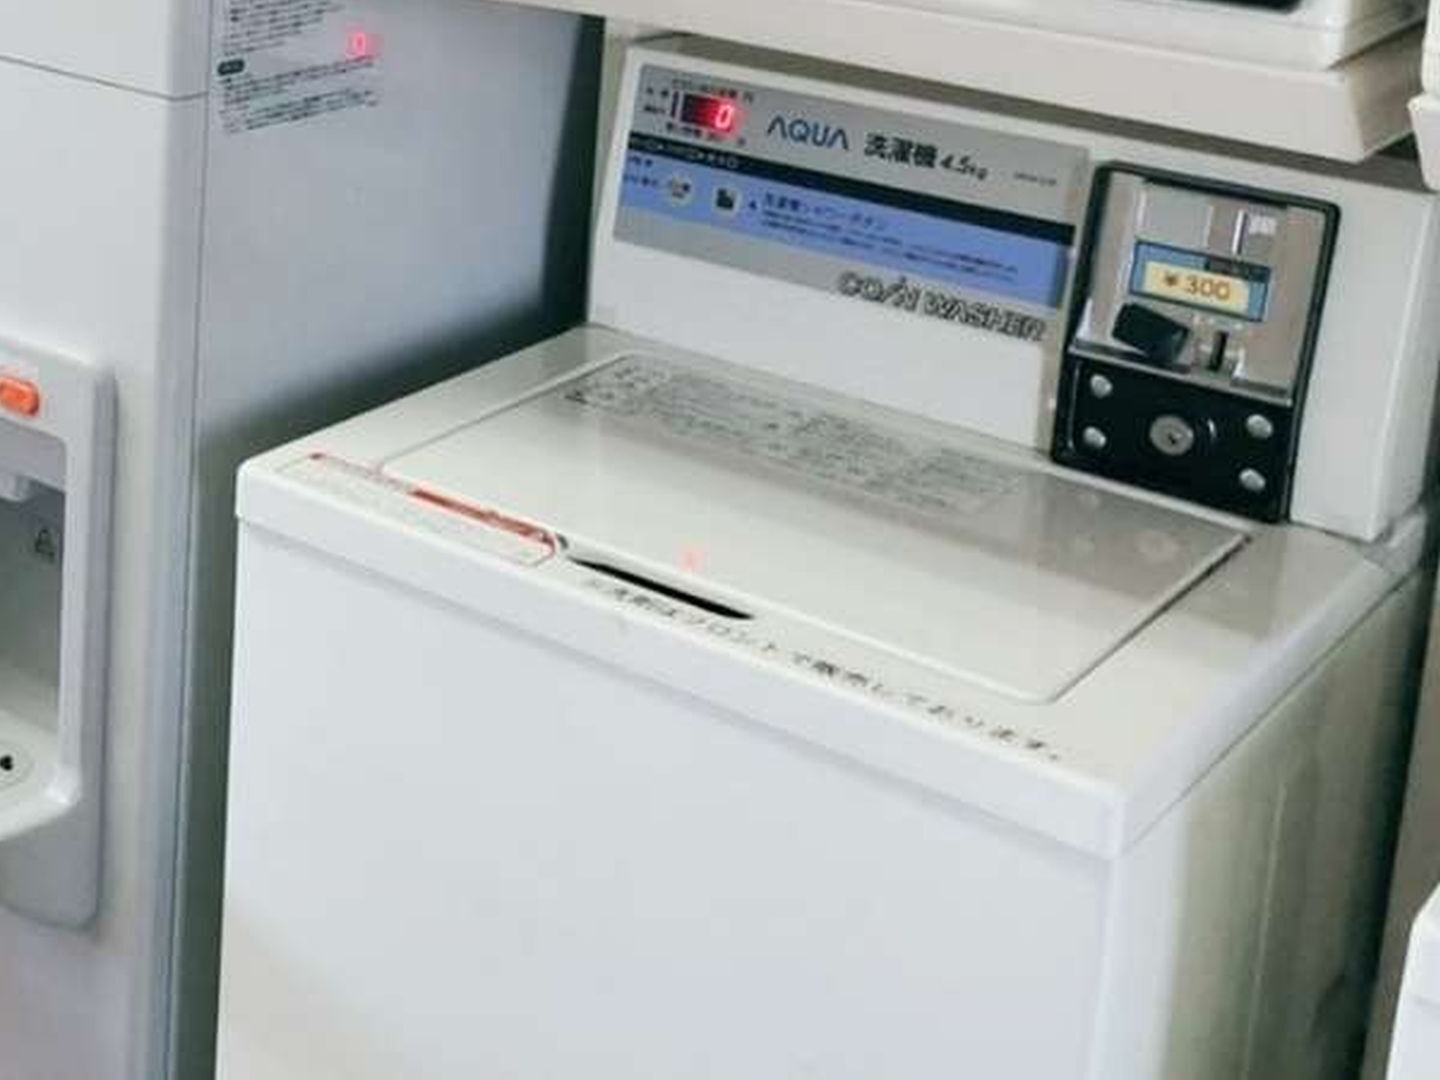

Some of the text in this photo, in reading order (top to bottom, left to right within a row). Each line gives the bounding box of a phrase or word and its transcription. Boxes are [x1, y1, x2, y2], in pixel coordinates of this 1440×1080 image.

[714, 104, 735, 129] 0
[766, 115, 850, 153] AQUA
[864, 132, 938, 169] 洗濯機
